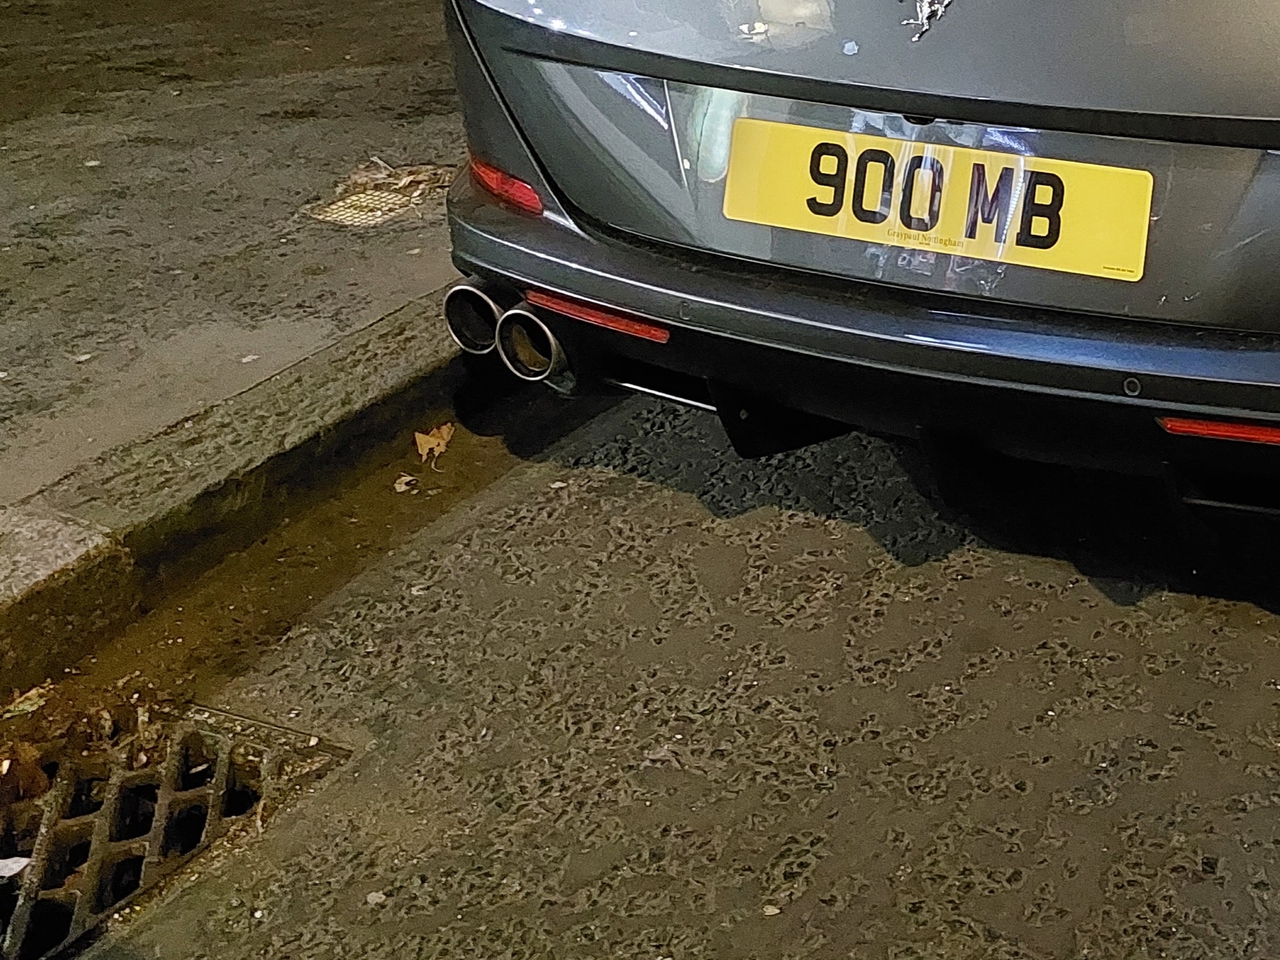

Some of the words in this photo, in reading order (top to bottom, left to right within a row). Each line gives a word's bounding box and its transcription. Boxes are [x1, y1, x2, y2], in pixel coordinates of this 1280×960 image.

[806, 142, 944, 231] 900
[965, 162, 1066, 250] MB
[887, 228, 921, 243] Graypaul
[921, 234, 965, 249] Nottingham
